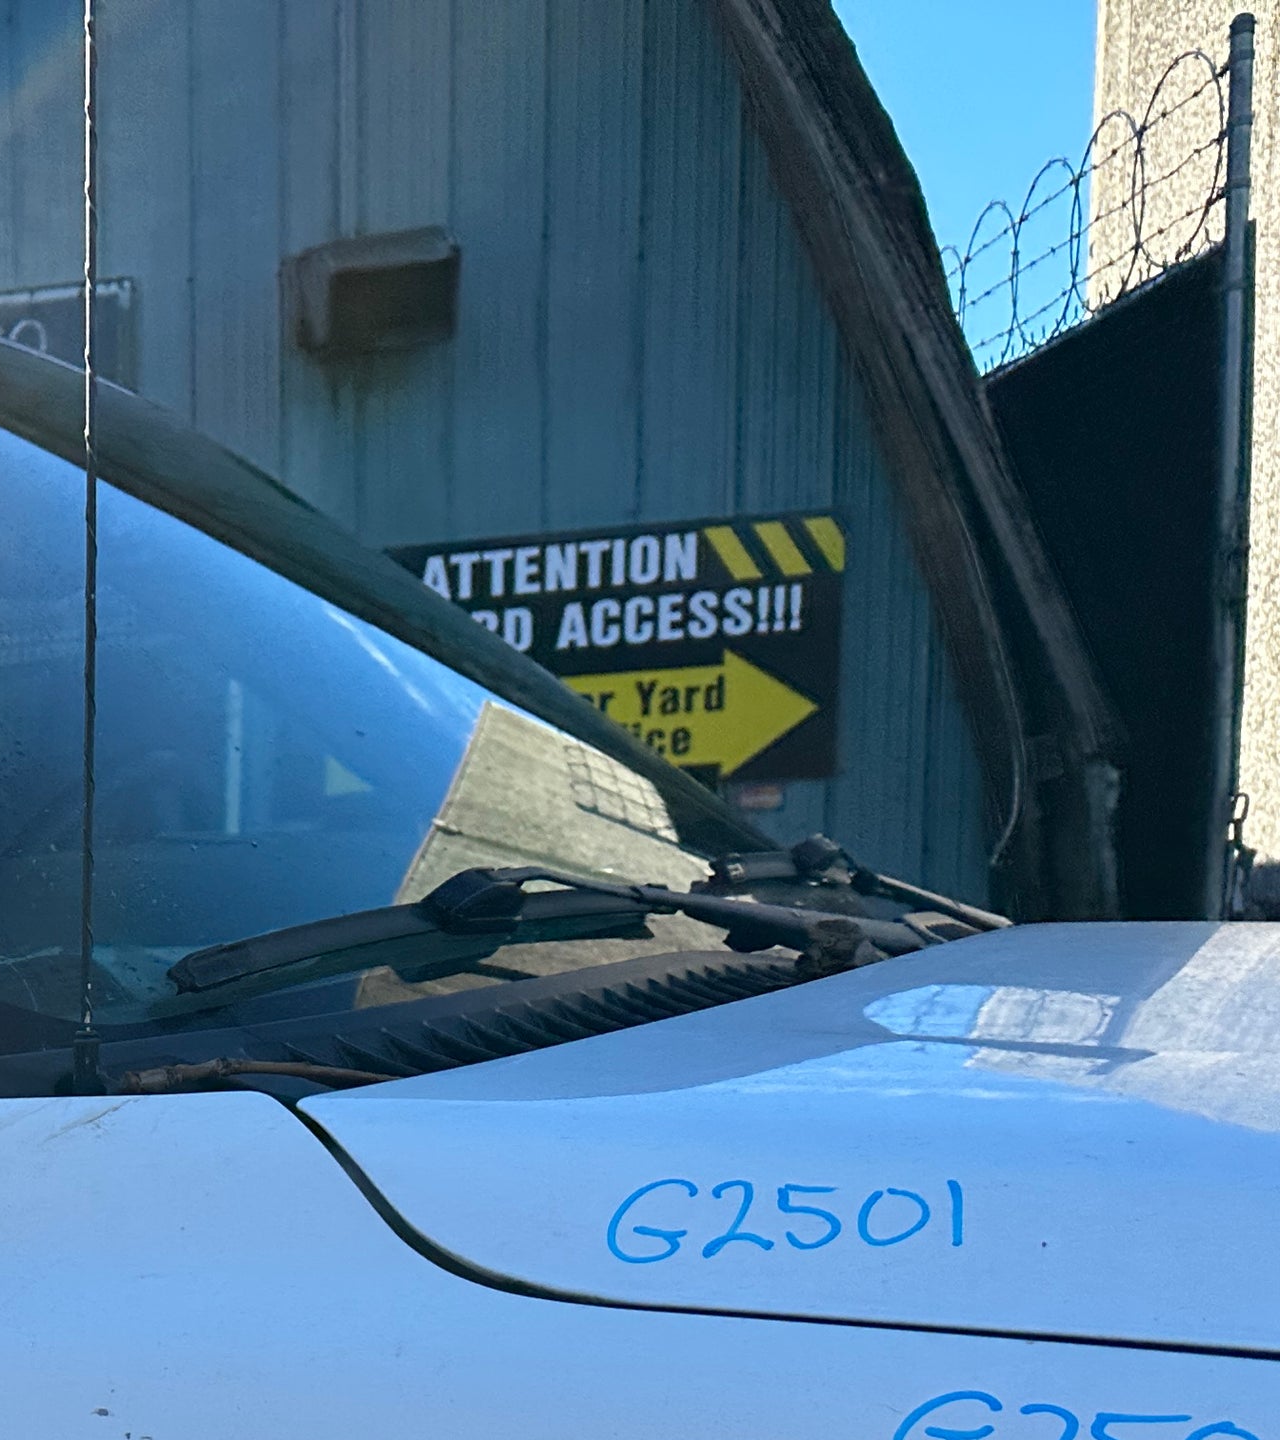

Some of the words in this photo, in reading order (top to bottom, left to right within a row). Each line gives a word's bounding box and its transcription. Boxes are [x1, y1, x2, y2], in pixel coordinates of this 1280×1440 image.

[423, 531, 698, 600] ATTENTION
[556, 583, 803, 650] ACCESS!!!
[636, 673, 725, 716] Yard
[607, 1178, 964, 1264] G2501
